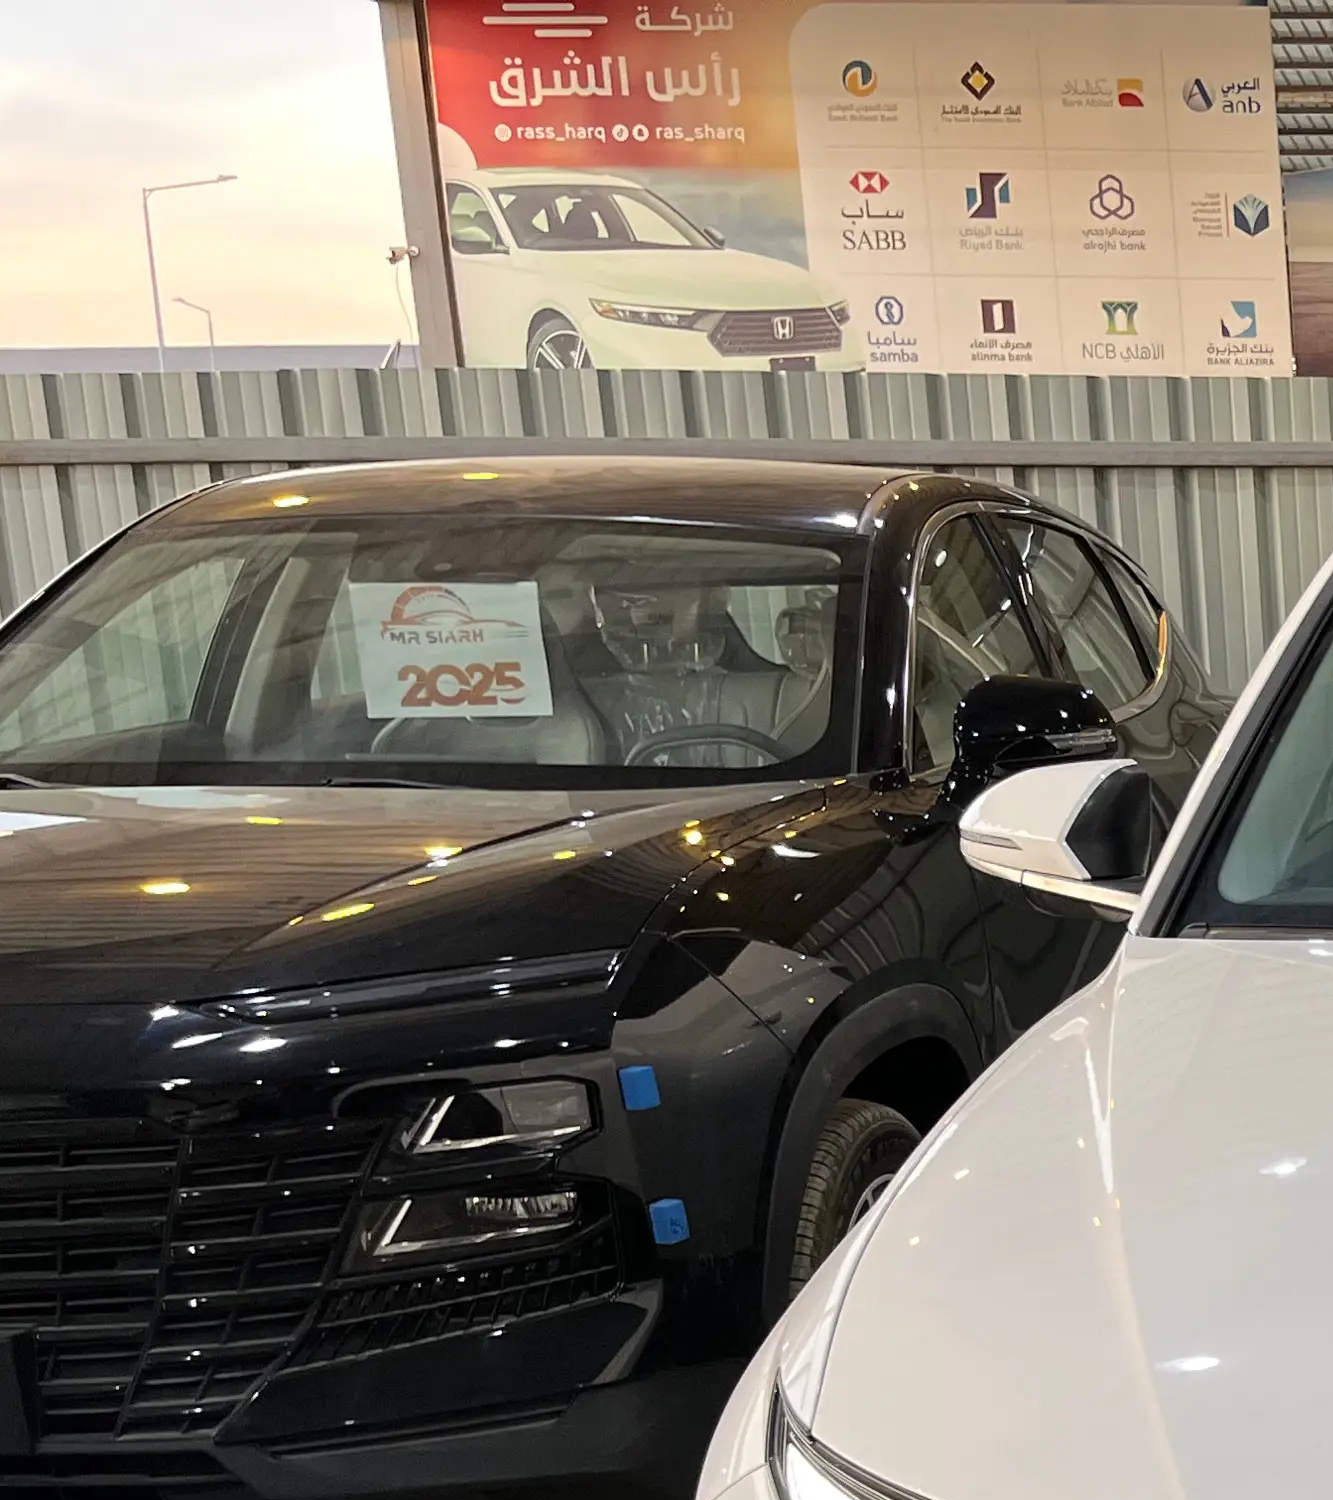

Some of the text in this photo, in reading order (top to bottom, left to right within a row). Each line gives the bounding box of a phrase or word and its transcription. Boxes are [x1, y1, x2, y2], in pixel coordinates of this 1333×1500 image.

[636, 3, 734, 37] شركة
[489, 50, 742, 107] رأس الشرق
[1221, 78, 1260, 97] العربي
[1222, 97, 1261, 114] anb
[517, 123, 745, 144] rass_harq ras_sharq
[841, 199, 905, 226] ساب
[842, 229, 906, 251] SABB
[1120, 241, 1147, 251] bank
[867, 331, 918, 350] سامبا
[869, 351, 919, 363] samba
[970, 353, 1033, 362] alinma bank
[1082, 343, 1117, 361] NCB
[1206, 343, 1275, 357] بنك الجزيرة
[1207, 358, 1231, 366] BANK
[389, 628, 484, 646] MR SIARH
[397, 662, 526, 708] 2025
